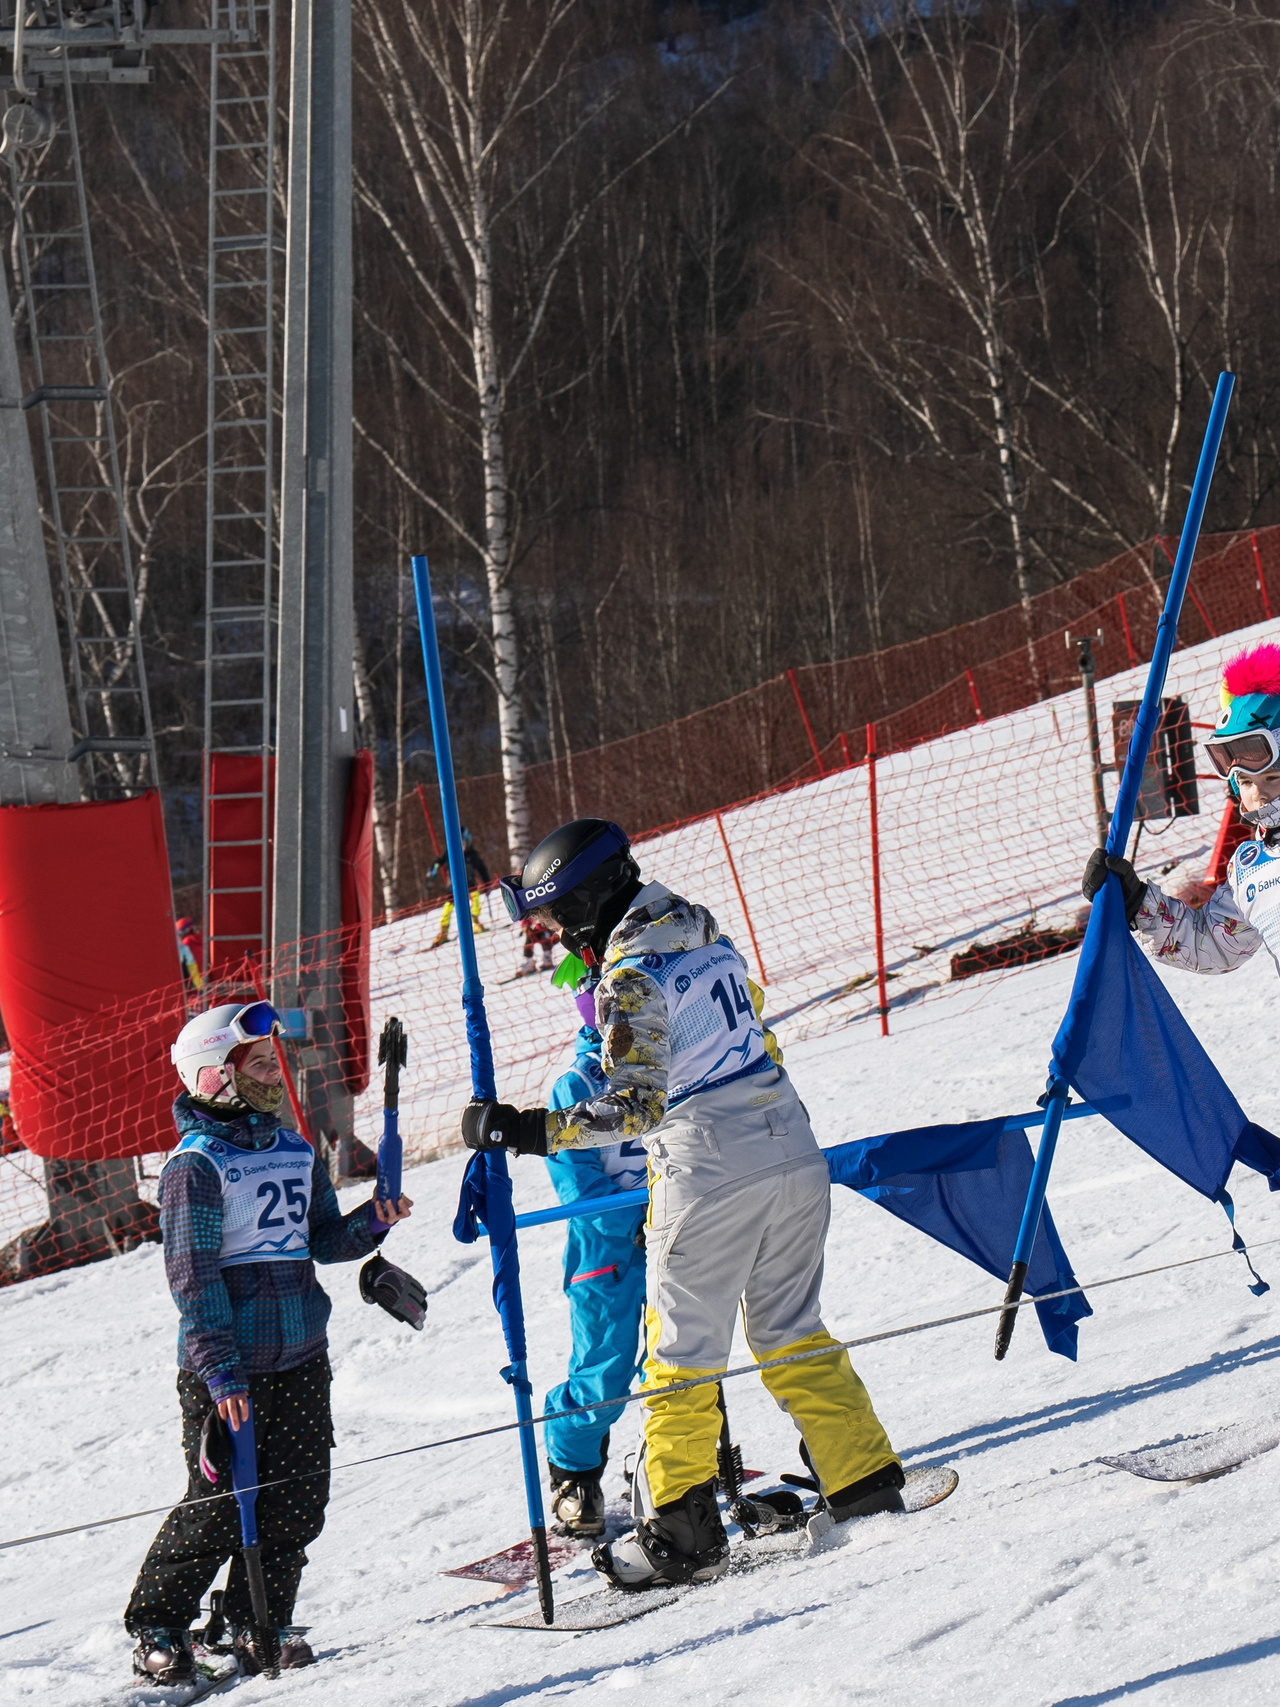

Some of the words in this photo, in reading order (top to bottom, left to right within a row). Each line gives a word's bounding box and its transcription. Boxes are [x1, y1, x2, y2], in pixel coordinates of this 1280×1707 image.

[1258, 876, 1280, 893] Банк
[689, 961, 712, 979] Банк
[710, 972, 755, 1032] 14
[203, 1033, 228, 1045] ROXY
[242, 1165, 268, 1176] Банк
[257, 1178, 308, 1230] 25
